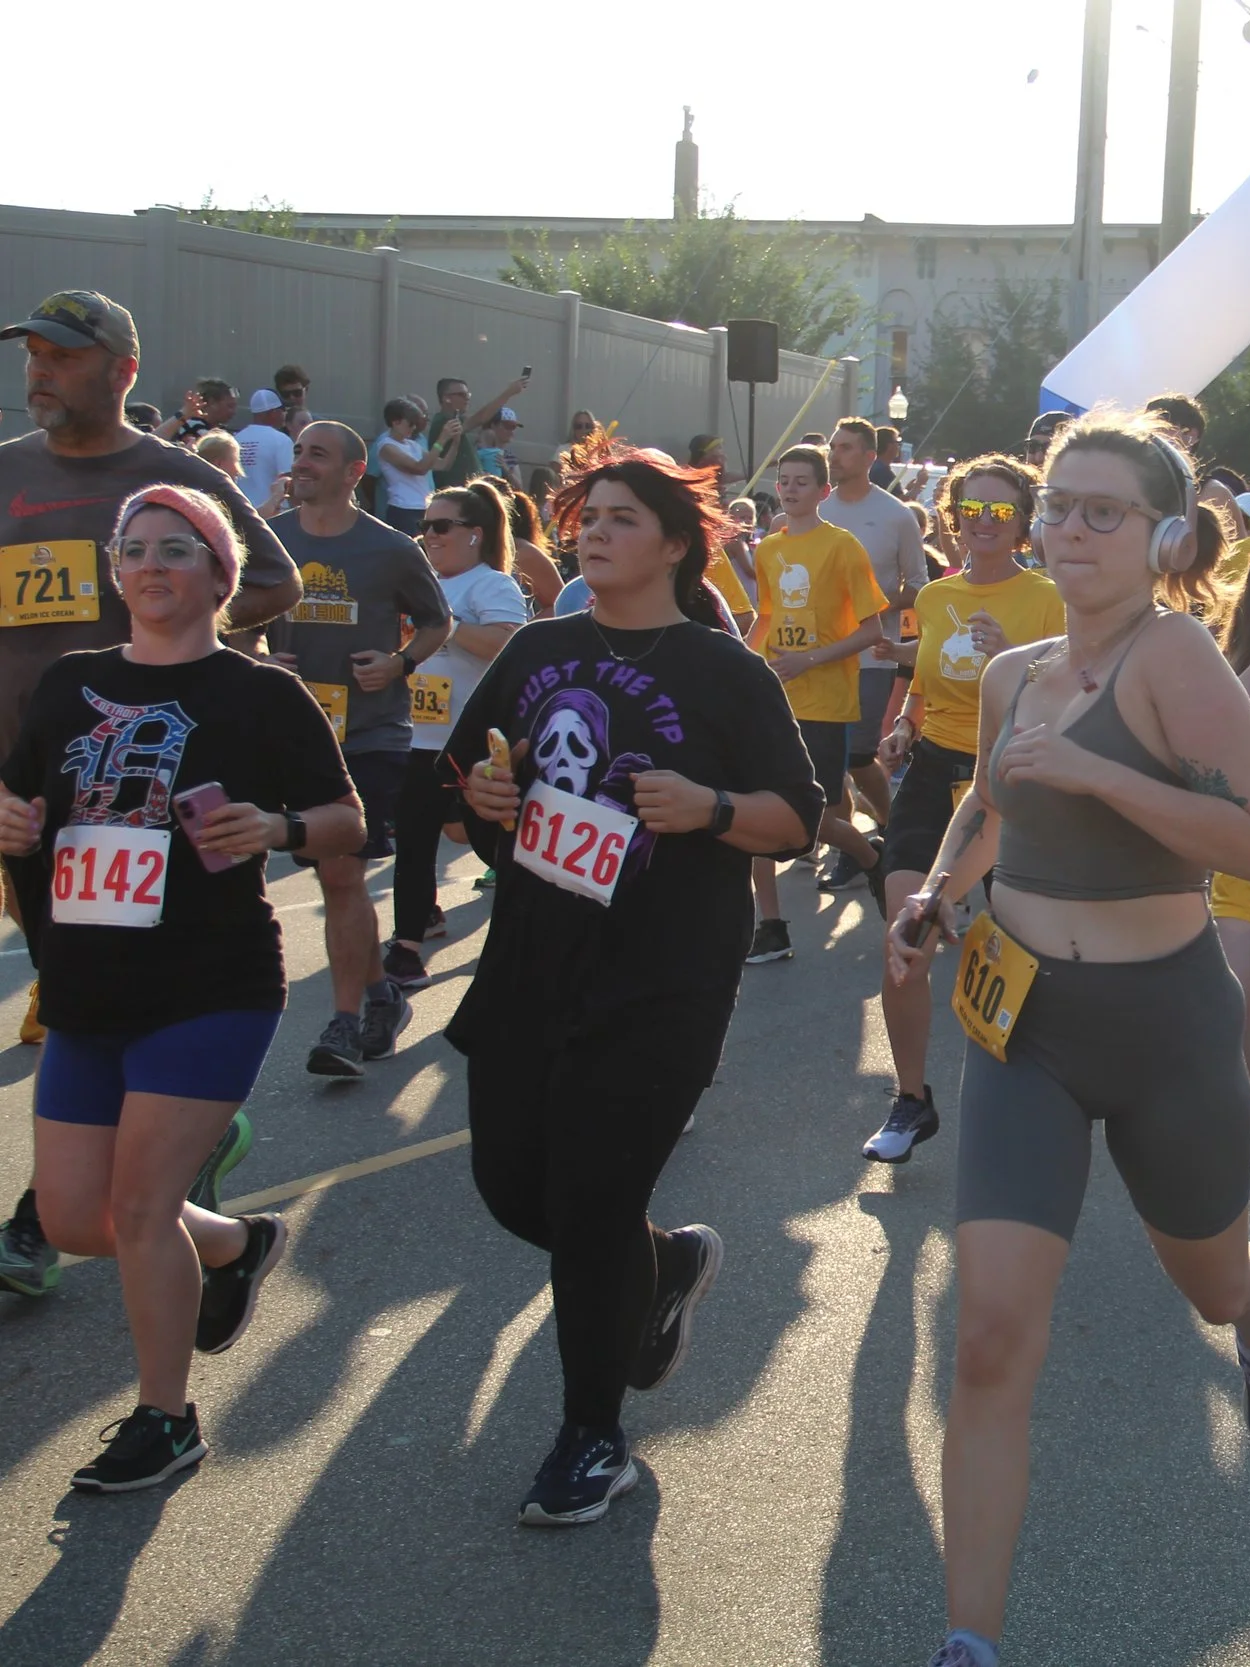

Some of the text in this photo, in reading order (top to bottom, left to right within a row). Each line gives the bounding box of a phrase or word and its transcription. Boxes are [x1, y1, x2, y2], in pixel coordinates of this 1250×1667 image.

[15, 567, 76, 606] 721
[777, 626, 807, 647] 132
[99, 699, 141, 718] DETROIT
[410, 688, 438, 711] 93
[517, 660, 684, 743] JUST THE TIP
[520, 800, 626, 886] 6126
[55, 846, 165, 906] 6142
[964, 949, 1005, 1024] 610
